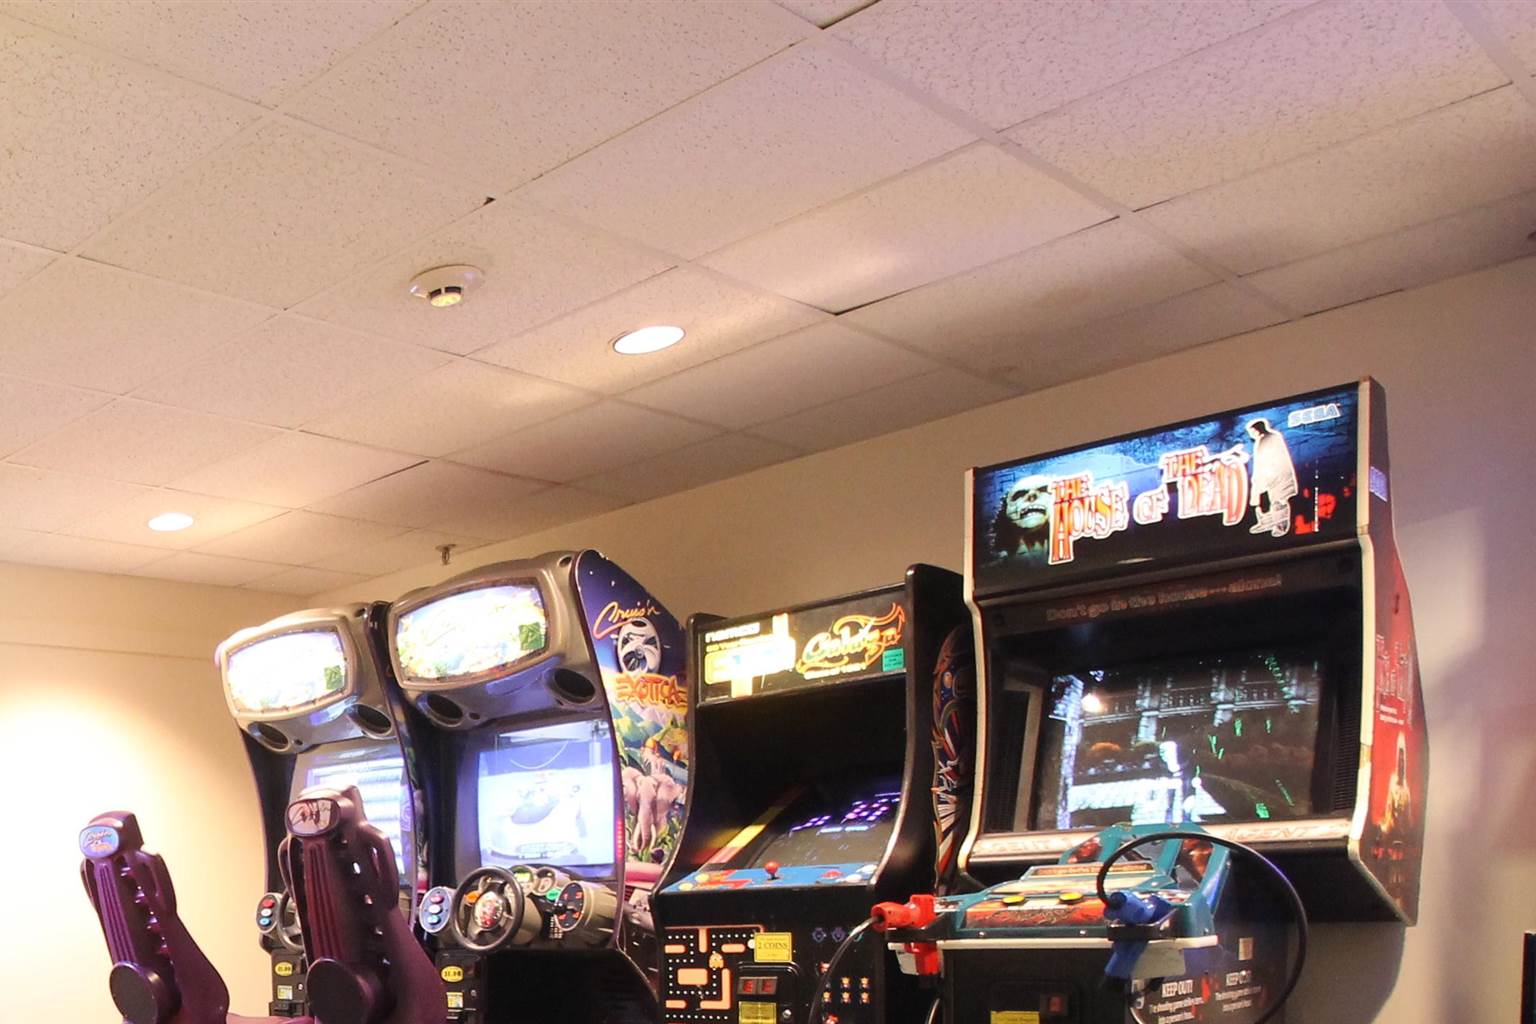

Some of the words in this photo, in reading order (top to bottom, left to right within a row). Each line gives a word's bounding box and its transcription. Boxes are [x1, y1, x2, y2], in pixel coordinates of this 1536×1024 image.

[1163, 447, 1207, 480] THE
[1051, 473, 1090, 501] THE
[1180, 461, 1247, 525] DEAD
[1050, 484, 1127, 562] HOUSE
[1135, 486, 1166, 523] OF
[1162, 981, 1178, 998] KEEP
